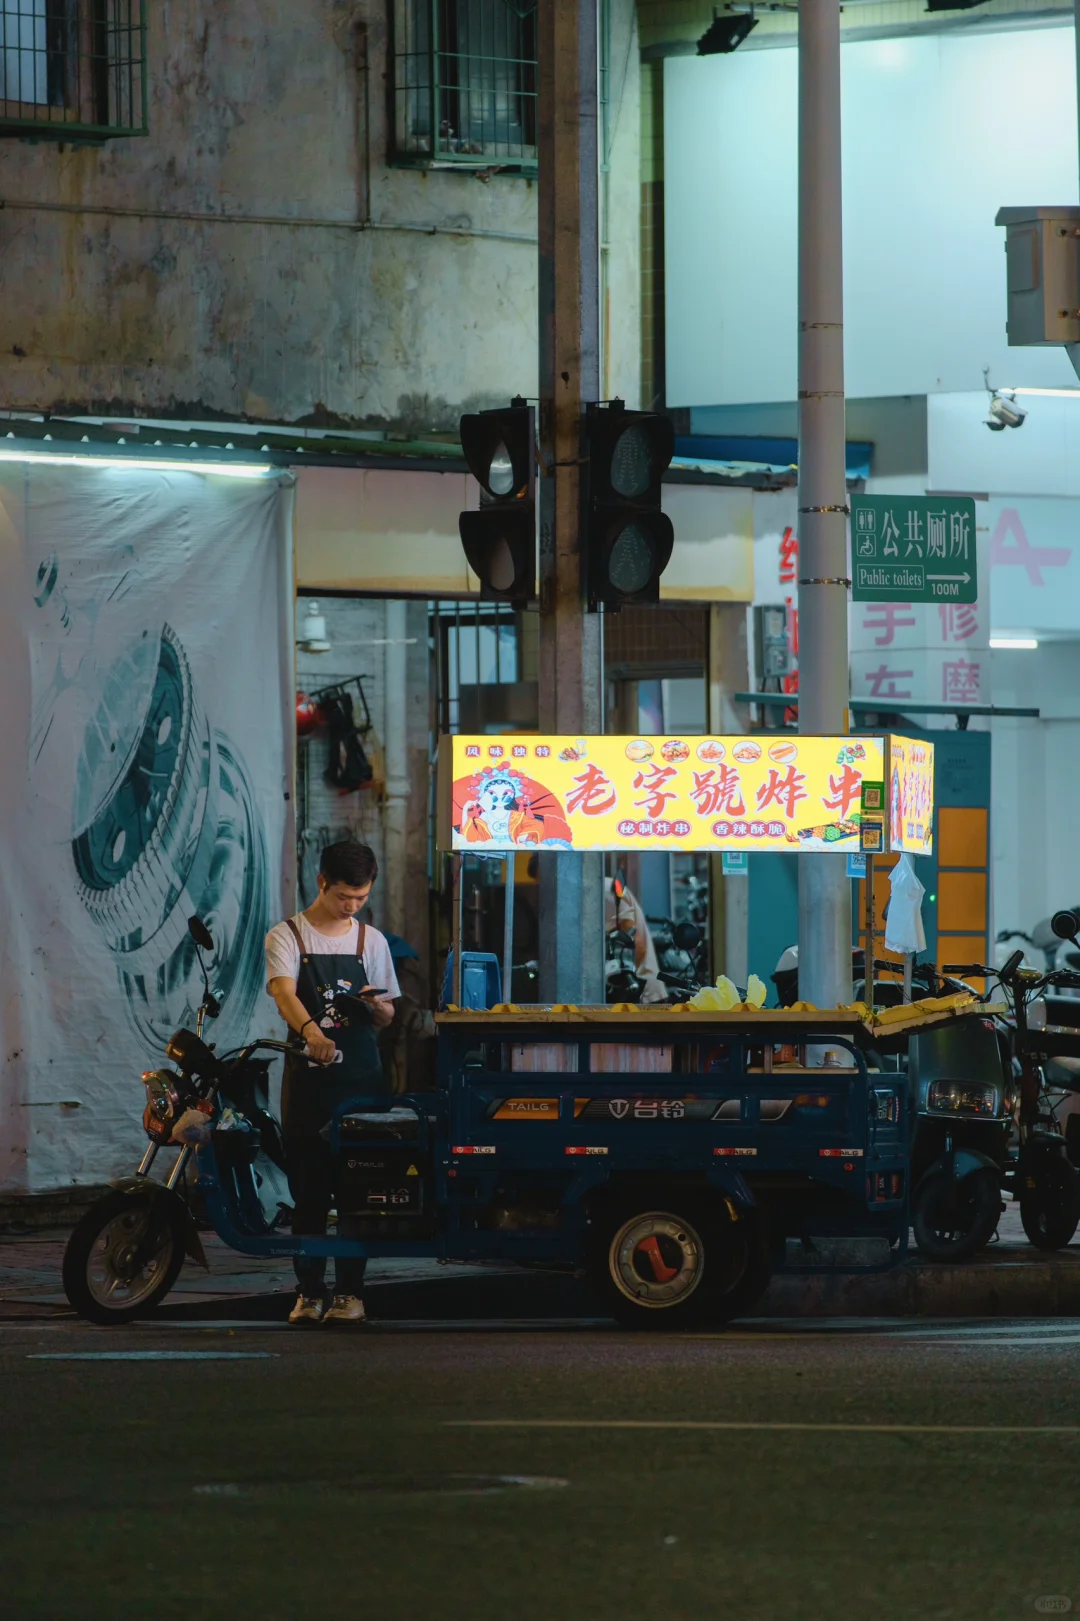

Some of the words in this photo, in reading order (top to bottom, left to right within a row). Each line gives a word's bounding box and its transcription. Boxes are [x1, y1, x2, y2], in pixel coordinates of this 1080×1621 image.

[880, 509, 970, 560] 公共厕所
[860, 569, 890, 585] Public
[893, 570, 922, 586] toilets
[931, 584, 959, 595] 100M
[466, 745, 551, 758] 风味独特
[564, 762, 863, 819] 老字號炸串
[620, 822, 690, 835] 秘制炸串
[715, 822, 784, 835] 香辣酥脆
[507, 1103, 549, 1111] TAILG
[634, 1100, 686, 1119] 台铃
